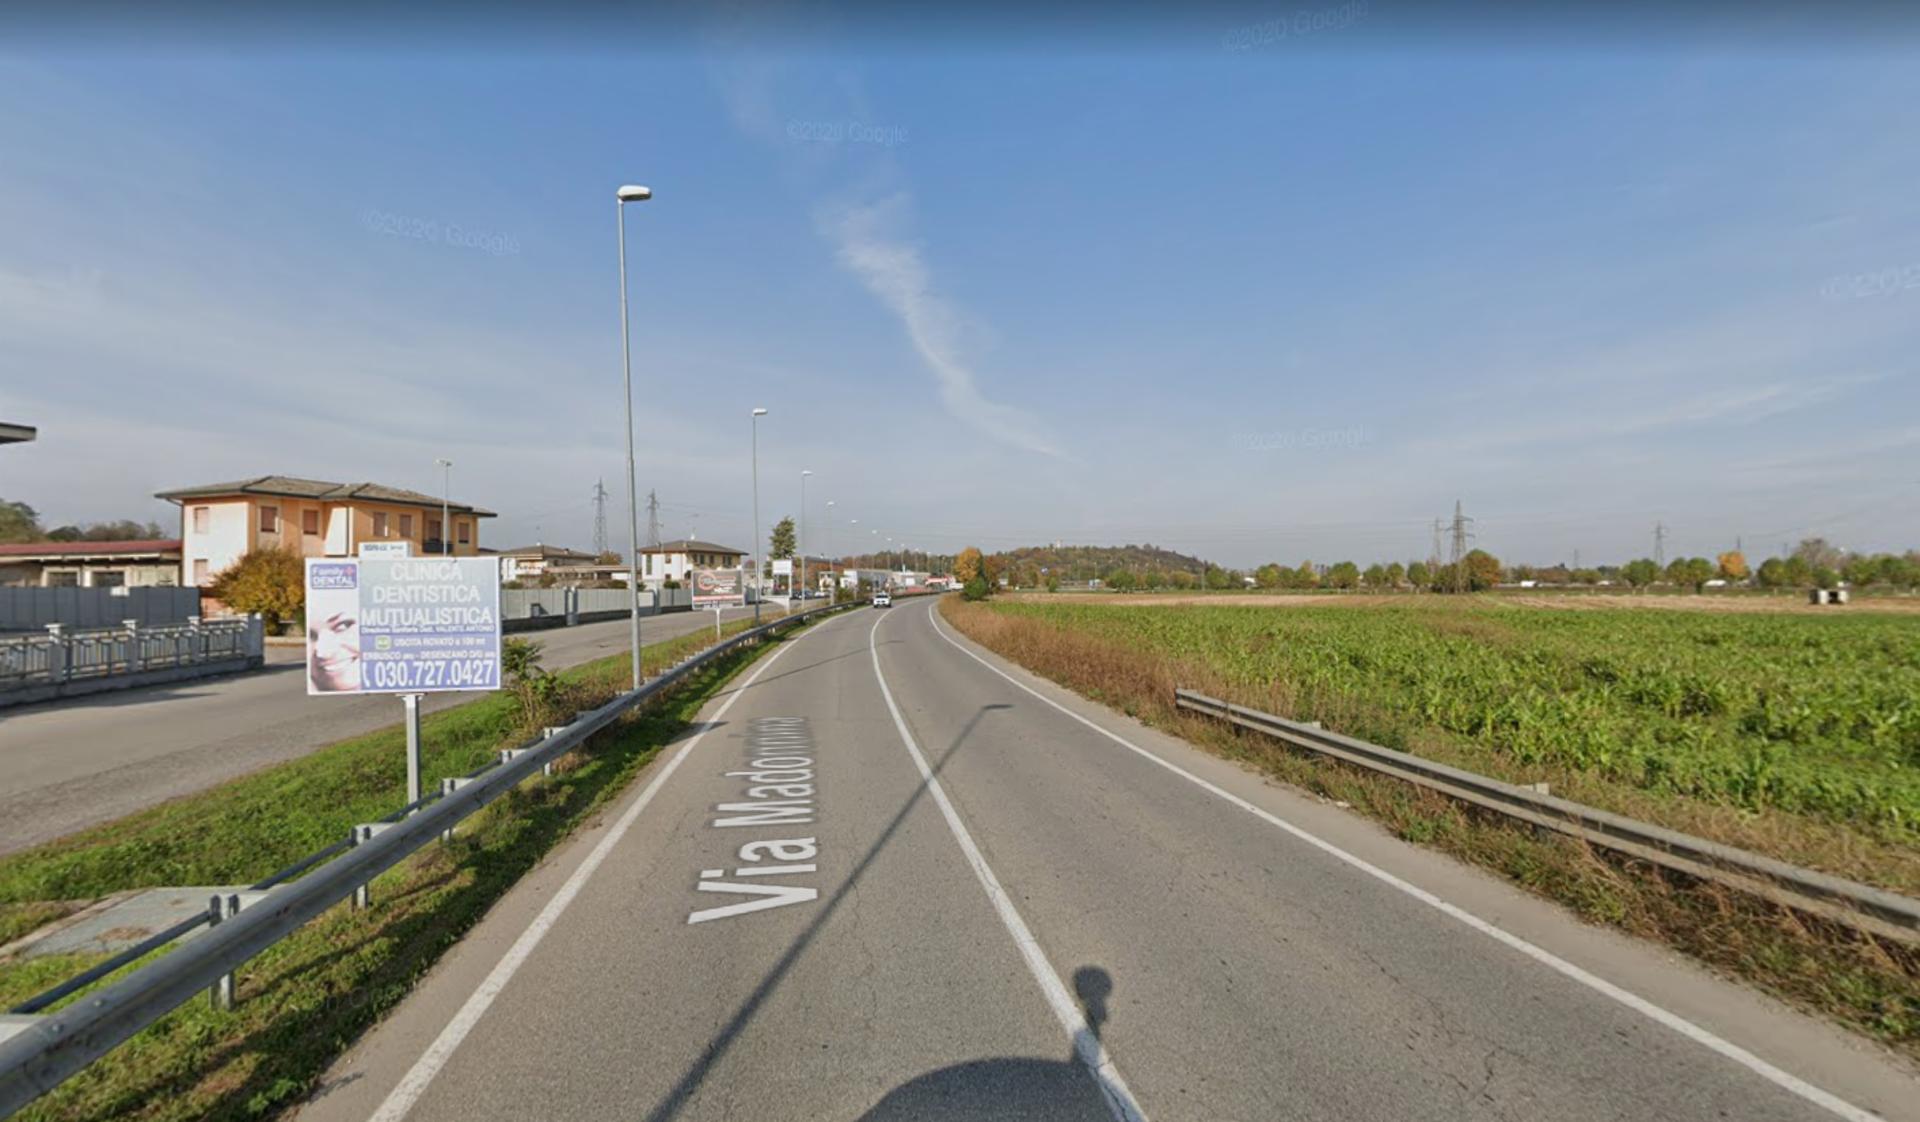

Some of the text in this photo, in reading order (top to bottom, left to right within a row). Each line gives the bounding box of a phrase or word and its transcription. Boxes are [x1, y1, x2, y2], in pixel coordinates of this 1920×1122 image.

[312, 566, 344, 577] Family
[391, 562, 463, 582] CLINICA
[312, 576, 354, 586] DENTAL
[372, 585, 481, 603] DENTISTICA
[361, 607, 493, 626] MUTUALISTICA
[374, 660, 494, 687] 030.727.0427
